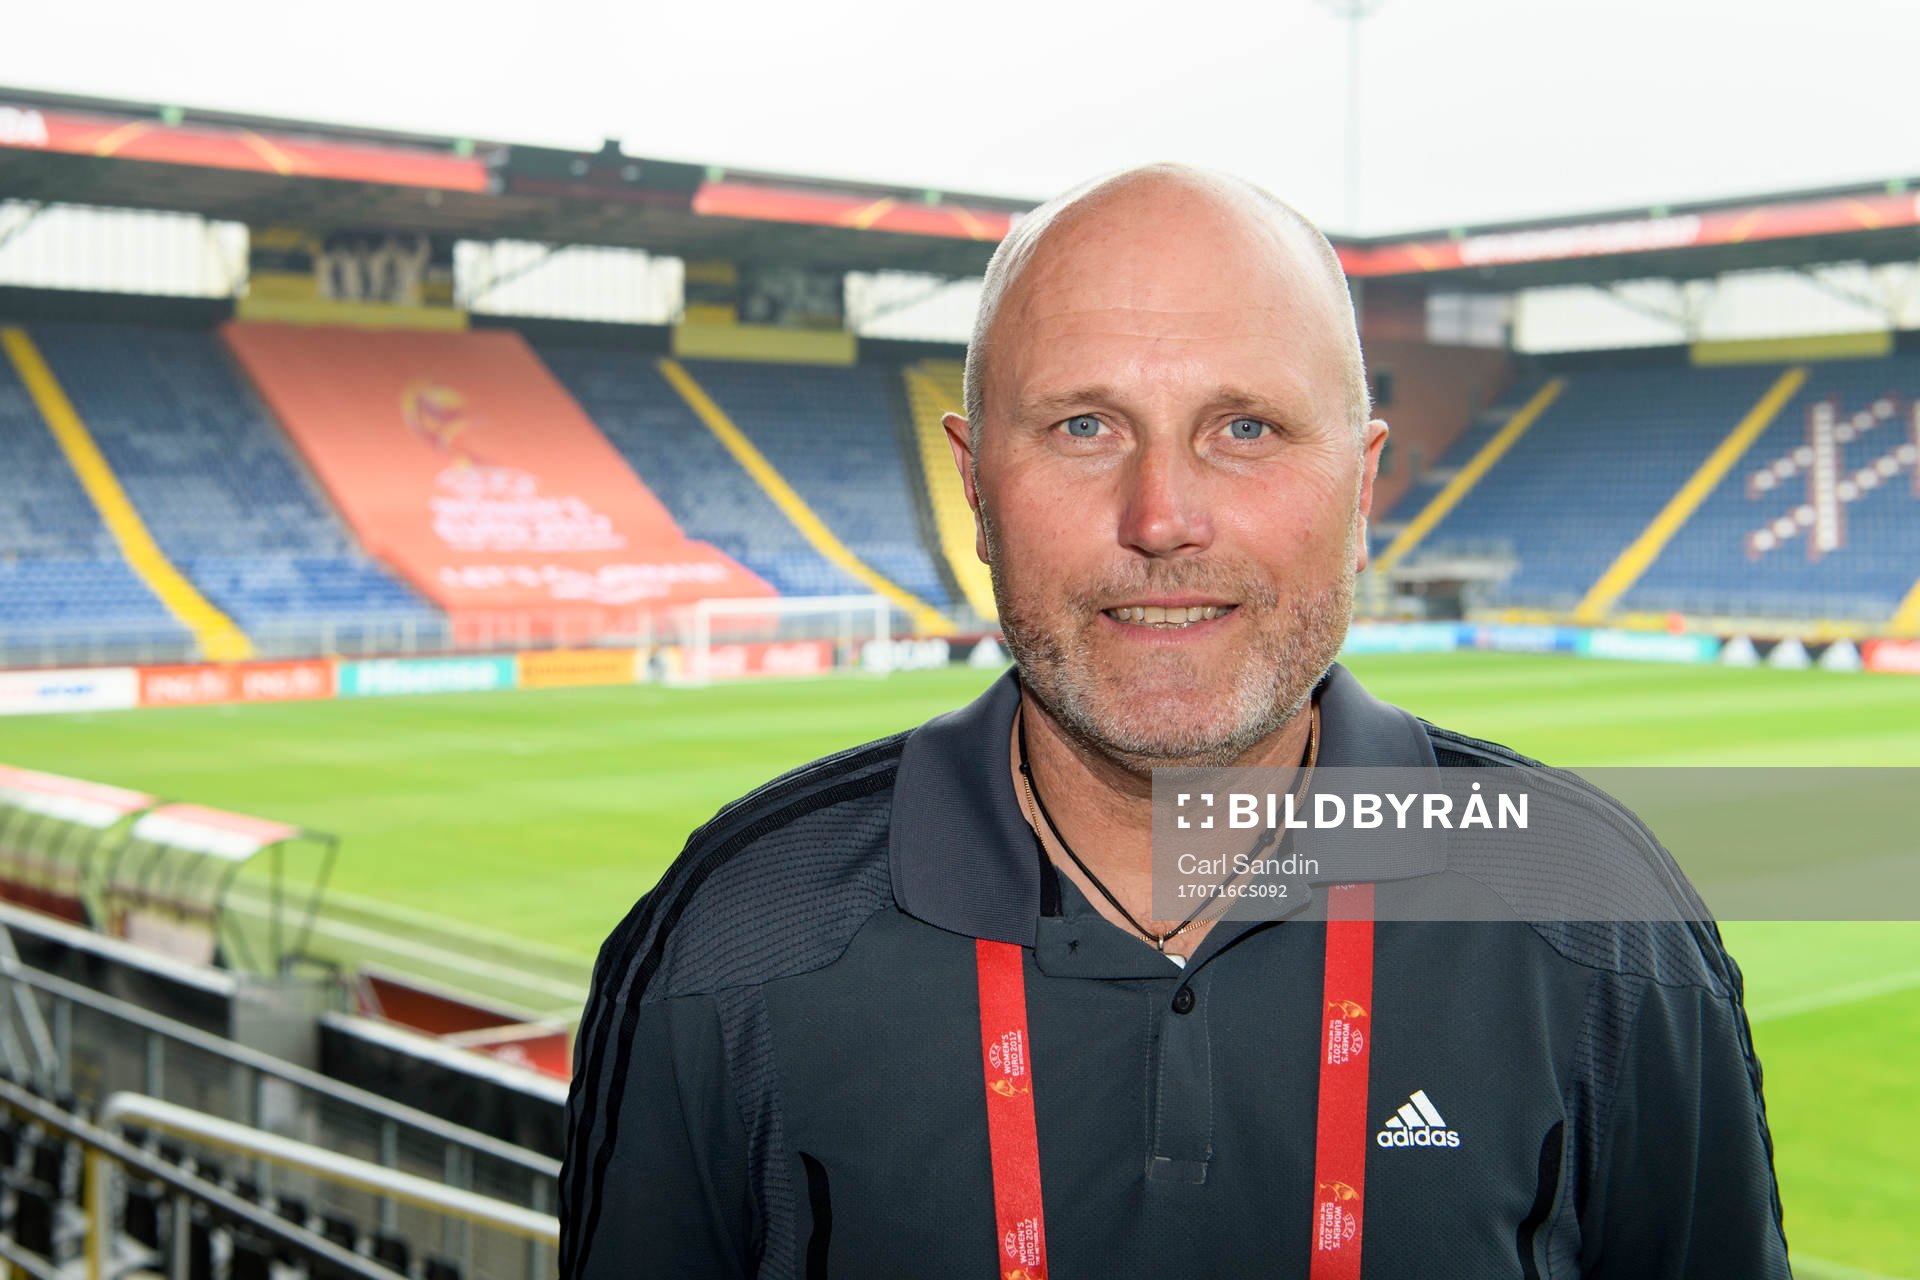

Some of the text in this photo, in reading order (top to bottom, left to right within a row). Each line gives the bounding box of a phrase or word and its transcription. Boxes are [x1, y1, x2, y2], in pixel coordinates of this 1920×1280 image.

[1334, 1020, 1342, 1042] EURO
[1350, 1029, 1363, 1055] UEFA
[989, 1043, 1002, 1068] UEFA
[1009, 1031, 1019, 1076] EURO 2017
[1377, 1126, 1460, 1147] adidas
[1326, 1202, 1334, 1226] EURO
[1342, 1212, 1356, 1240] UEFA
[1005, 1230, 1018, 1258] UEFA
[1025, 1218, 1035, 1266] EURO 2017
